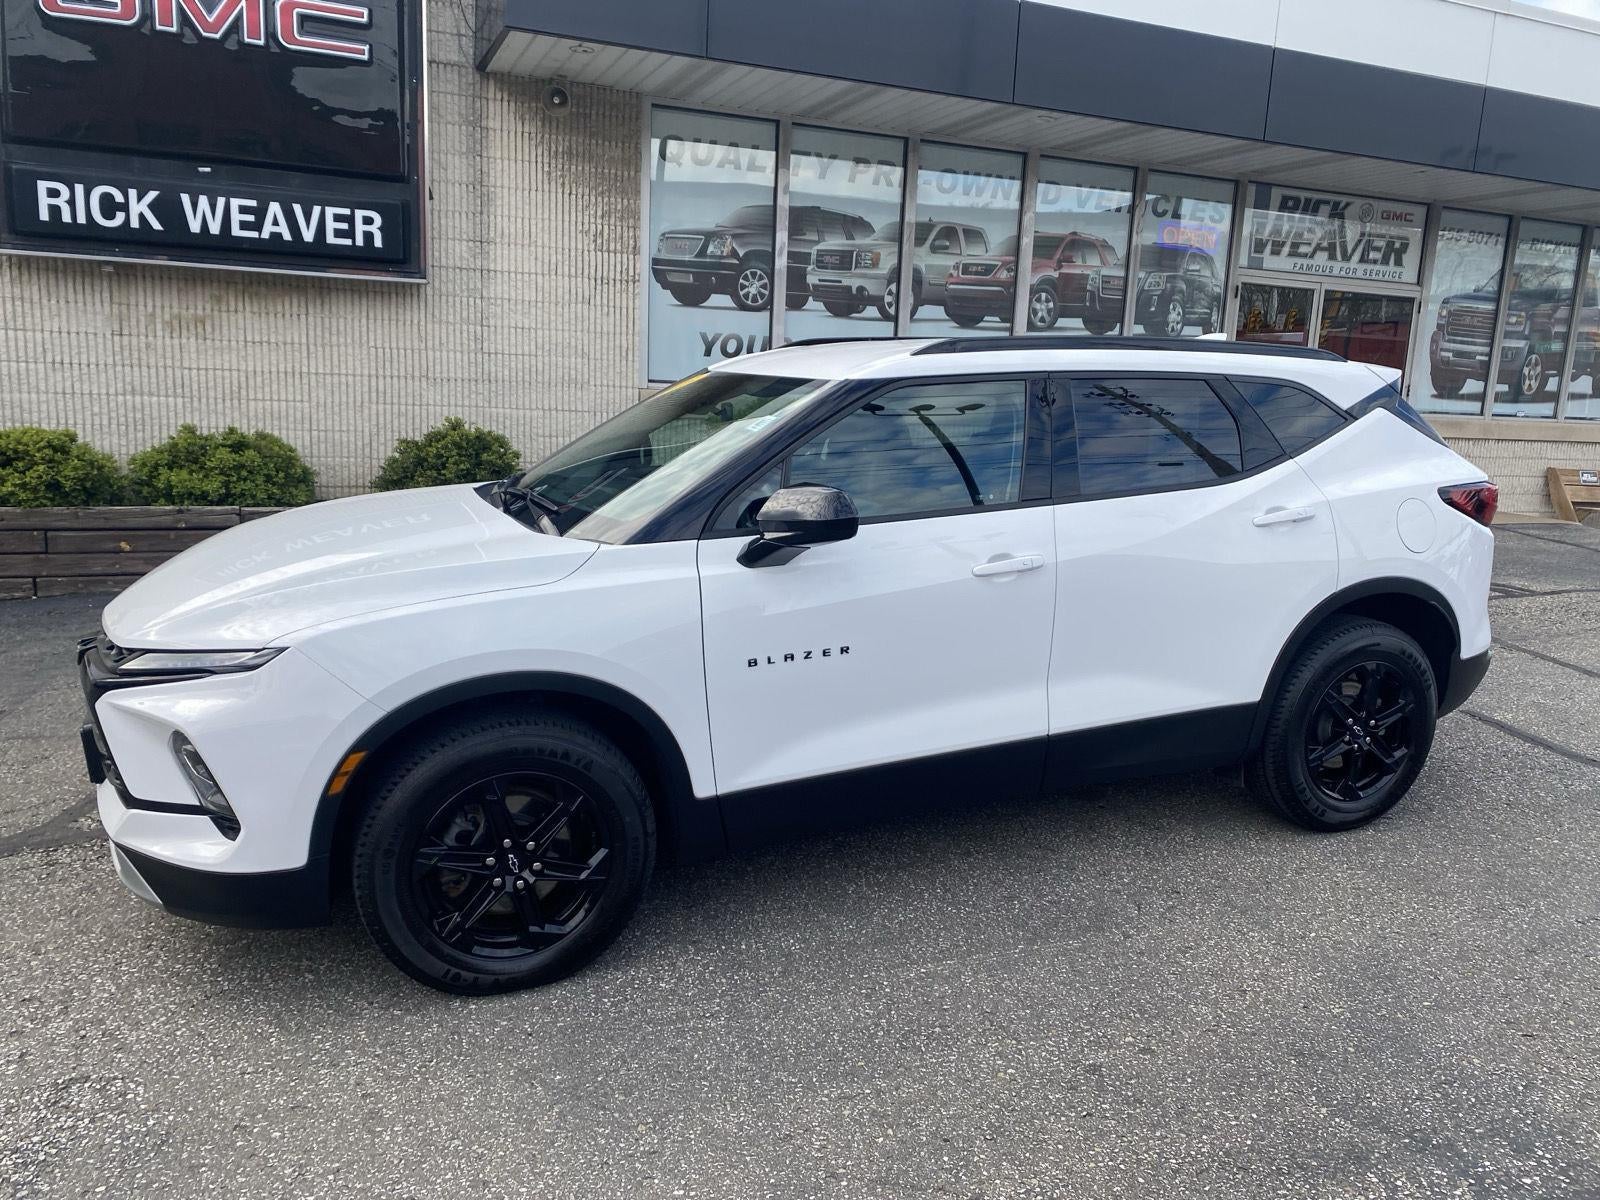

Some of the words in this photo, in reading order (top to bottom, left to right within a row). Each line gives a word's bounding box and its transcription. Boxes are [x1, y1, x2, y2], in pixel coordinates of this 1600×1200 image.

[659, 134, 839, 180] QUALTY
[847, 157, 1062, 205] PR-OWND
[1075, 184, 1228, 224] VEHCLES
[36, 179, 165, 232] RICK
[179, 192, 384, 249] WEAVER
[1273, 194, 1355, 226] RICK
[1380, 209, 1415, 223] GMC
[1162, 226, 1217, 249] OPEN
[1253, 217, 1410, 266] WEAVER
[1292, 262, 1334, 275] FAMOUS
[1338, 266, 1358, 277] FOR
[1362, 268, 1405, 280] SERVICE
[699, 331, 792, 358] YOU
[747, 645, 850, 668] BLAZER
